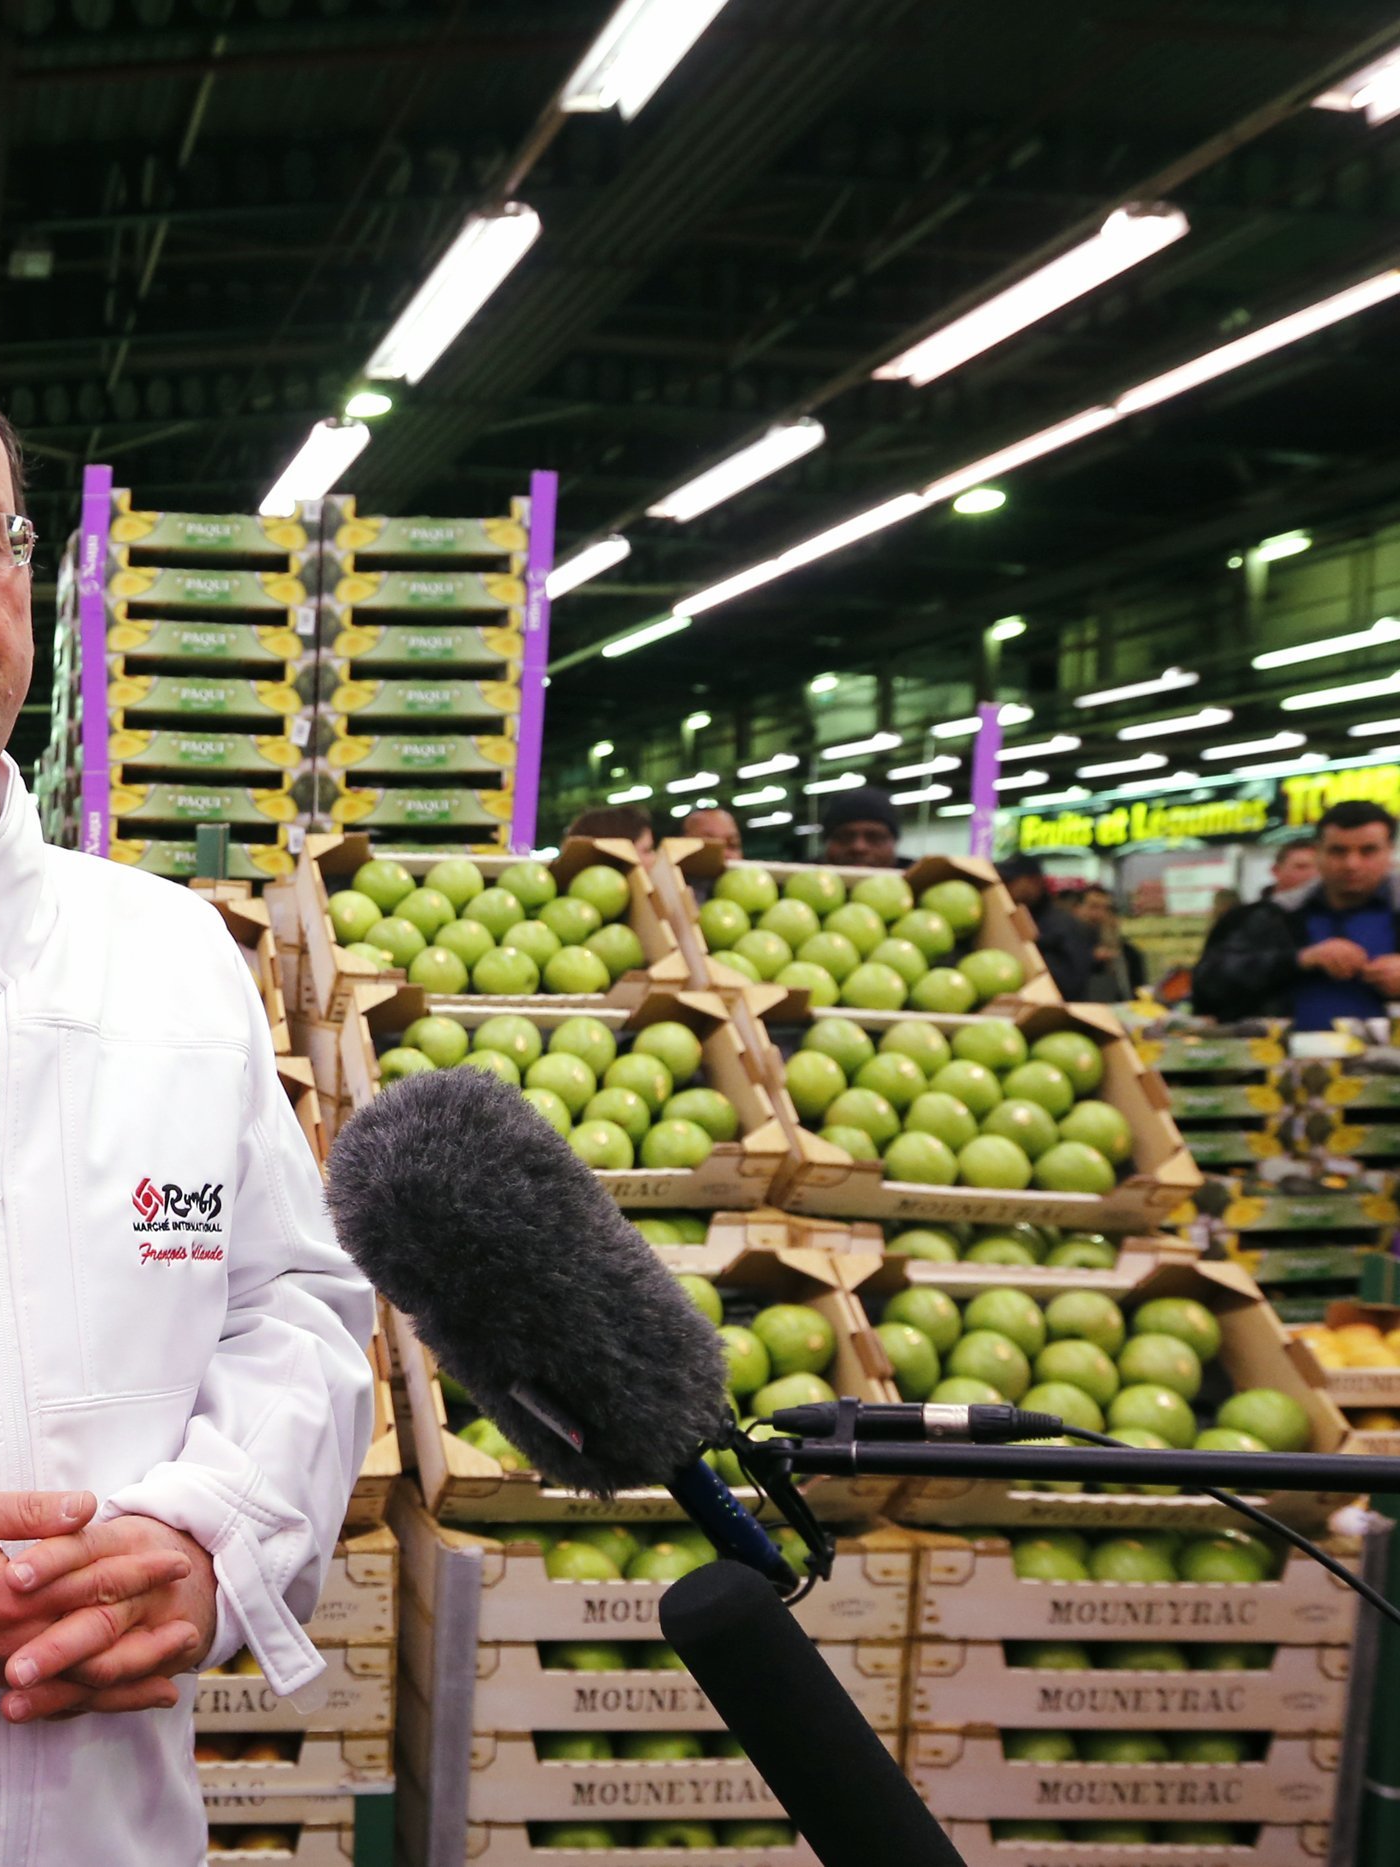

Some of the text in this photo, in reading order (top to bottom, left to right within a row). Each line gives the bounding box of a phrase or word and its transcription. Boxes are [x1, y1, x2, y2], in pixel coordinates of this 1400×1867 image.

[1020, 811, 1094, 849] Fruits
[1095, 807, 1129, 846] et
[133, 1218, 222, 1232] MARCHÉ INTERNATIONAL
[1048, 1600, 1256, 1626] MOUNEYRAC
[1038, 1688, 1245, 1713] MOUNEYRAC
[1038, 1780, 1243, 1805] MOUNEYRAC
